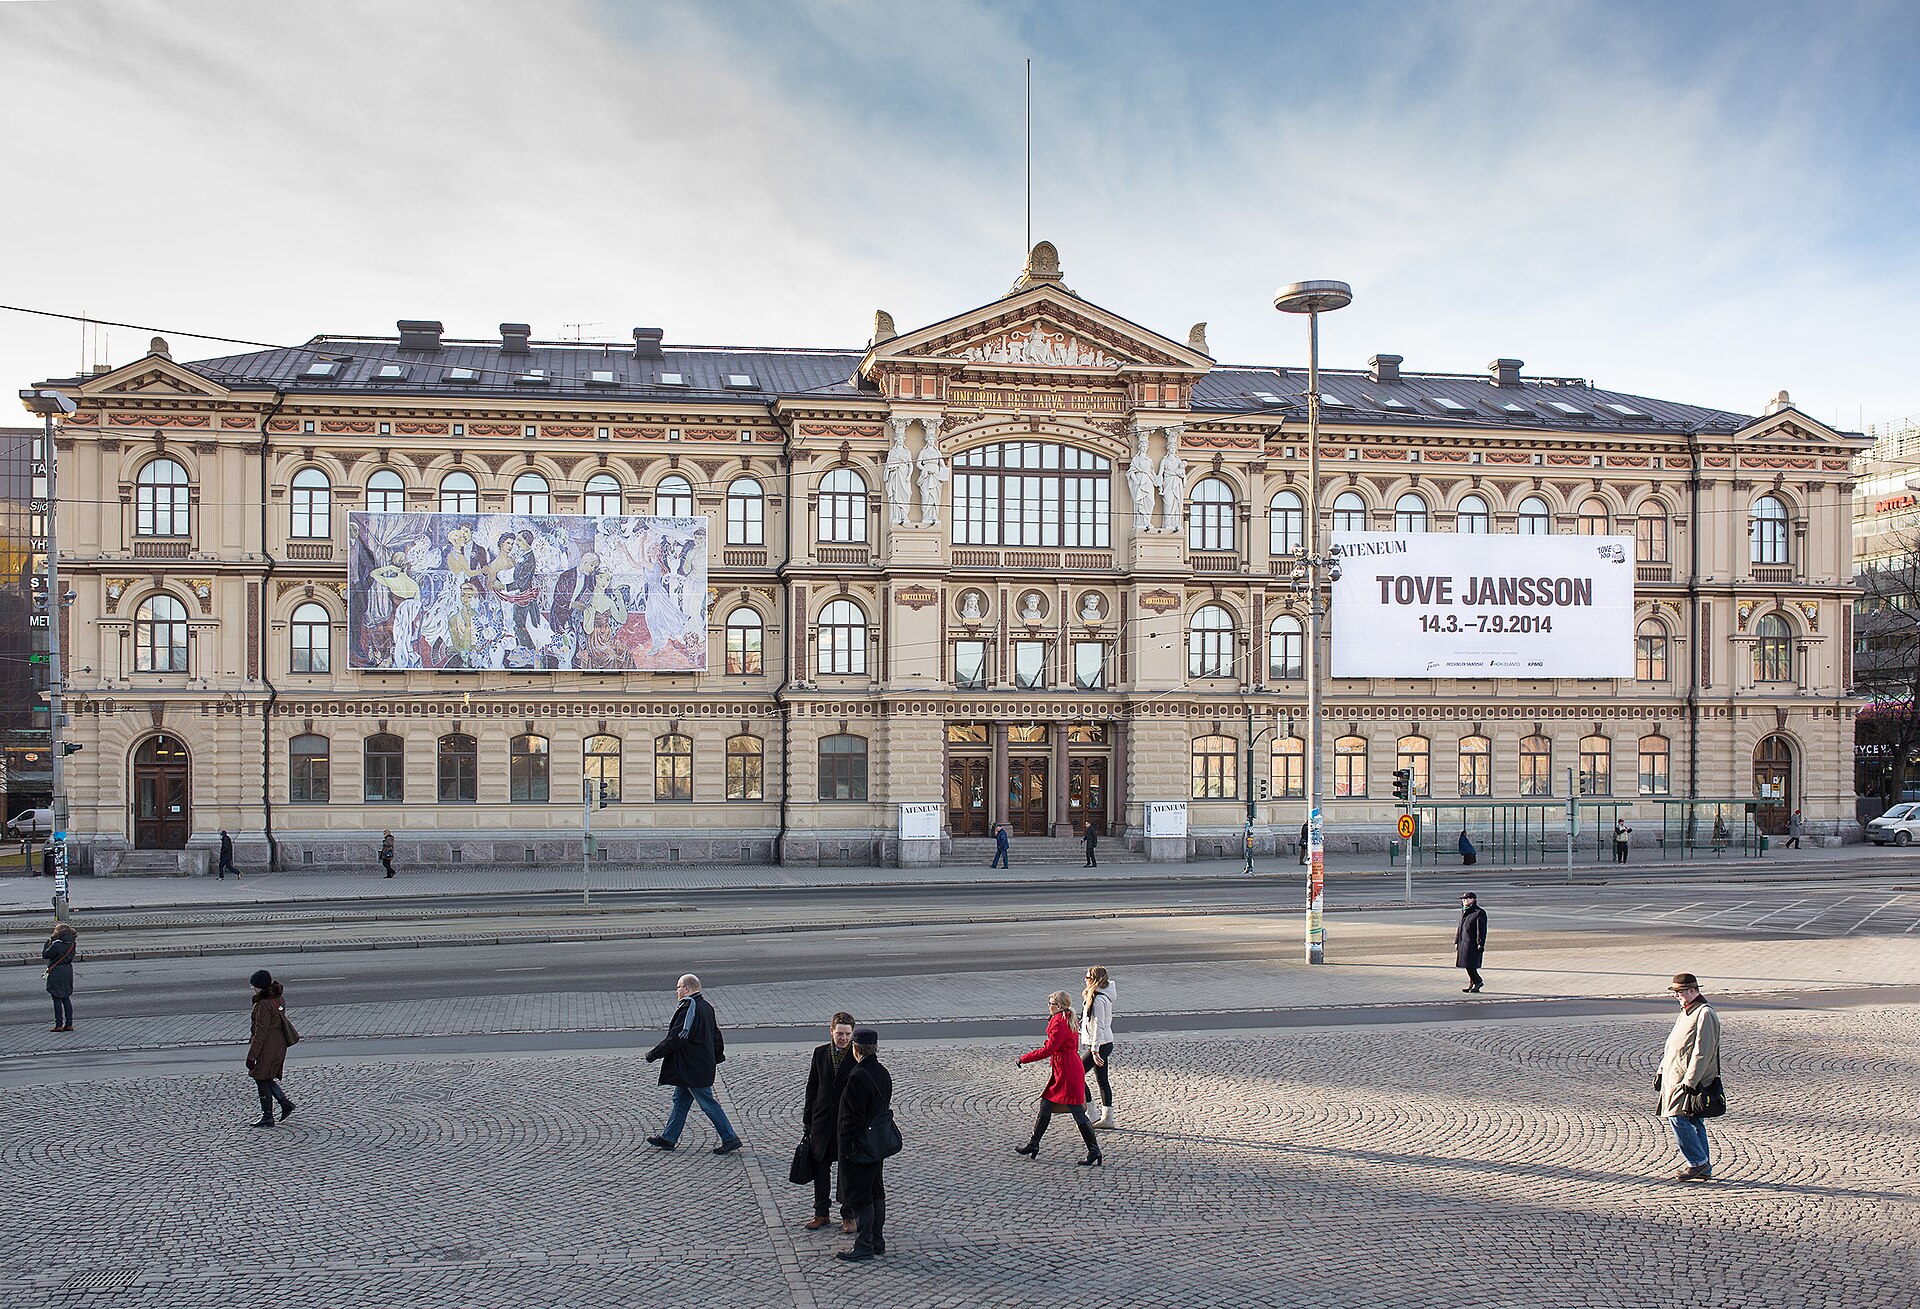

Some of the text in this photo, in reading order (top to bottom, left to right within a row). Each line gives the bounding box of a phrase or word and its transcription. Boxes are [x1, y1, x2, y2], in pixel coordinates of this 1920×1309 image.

[947, 390, 1003, 407] CONCORDIA
[1340, 540, 1407, 557] ATENEUM
[1376, 575, 1592, 606] TOVE JANSSON
[904, 804, 939, 814] ATENEUM
[1152, 803, 1186, 813] ATENEUM
